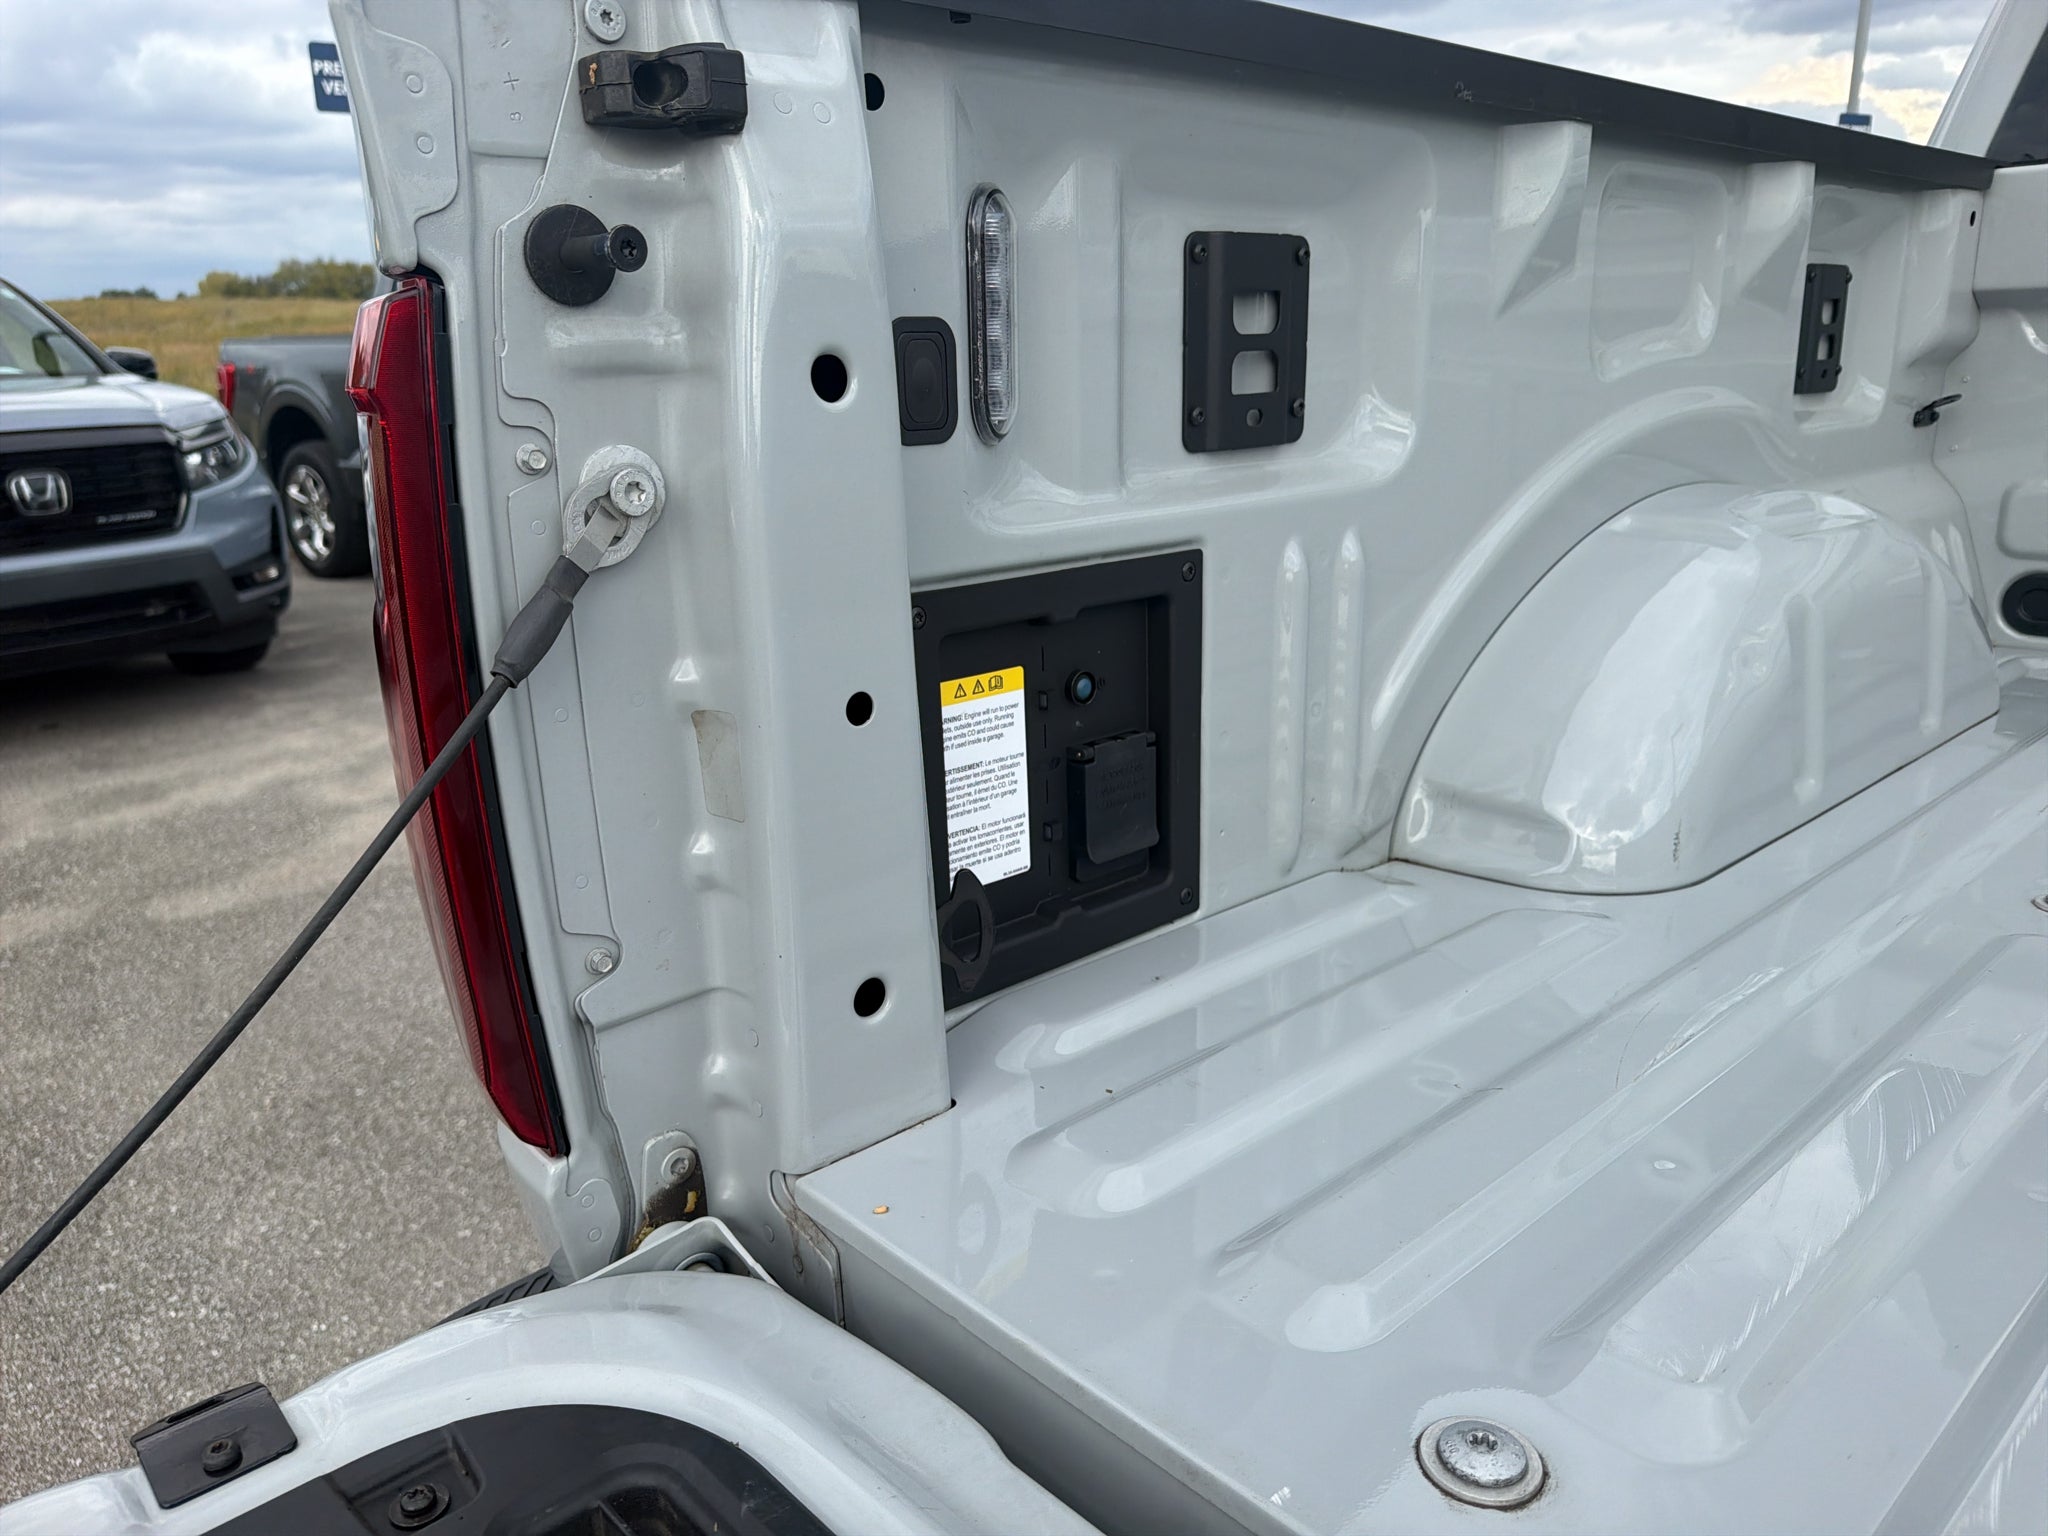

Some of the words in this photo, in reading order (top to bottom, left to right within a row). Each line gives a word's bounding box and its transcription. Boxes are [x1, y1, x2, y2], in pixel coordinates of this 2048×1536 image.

[964, 712, 981, 720] Engine
[1005, 703, 1019, 711] power
[954, 722, 971, 731] outside
[987, 724, 1000, 732] could
[955, 741, 966, 749] used
[987, 733, 1004, 742] garage.
[950, 774, 972, 784] alimenter
[981, 768, 996, 777] prises.
[998, 762, 1020, 771] Utilisation
[994, 772, 1010, 781] Quand
[1001, 788, 1017, 798] garage
[953, 838, 968, 847] activar
[965, 859, 981, 869] muerte
[1004, 847, 1022, 856] adentro
